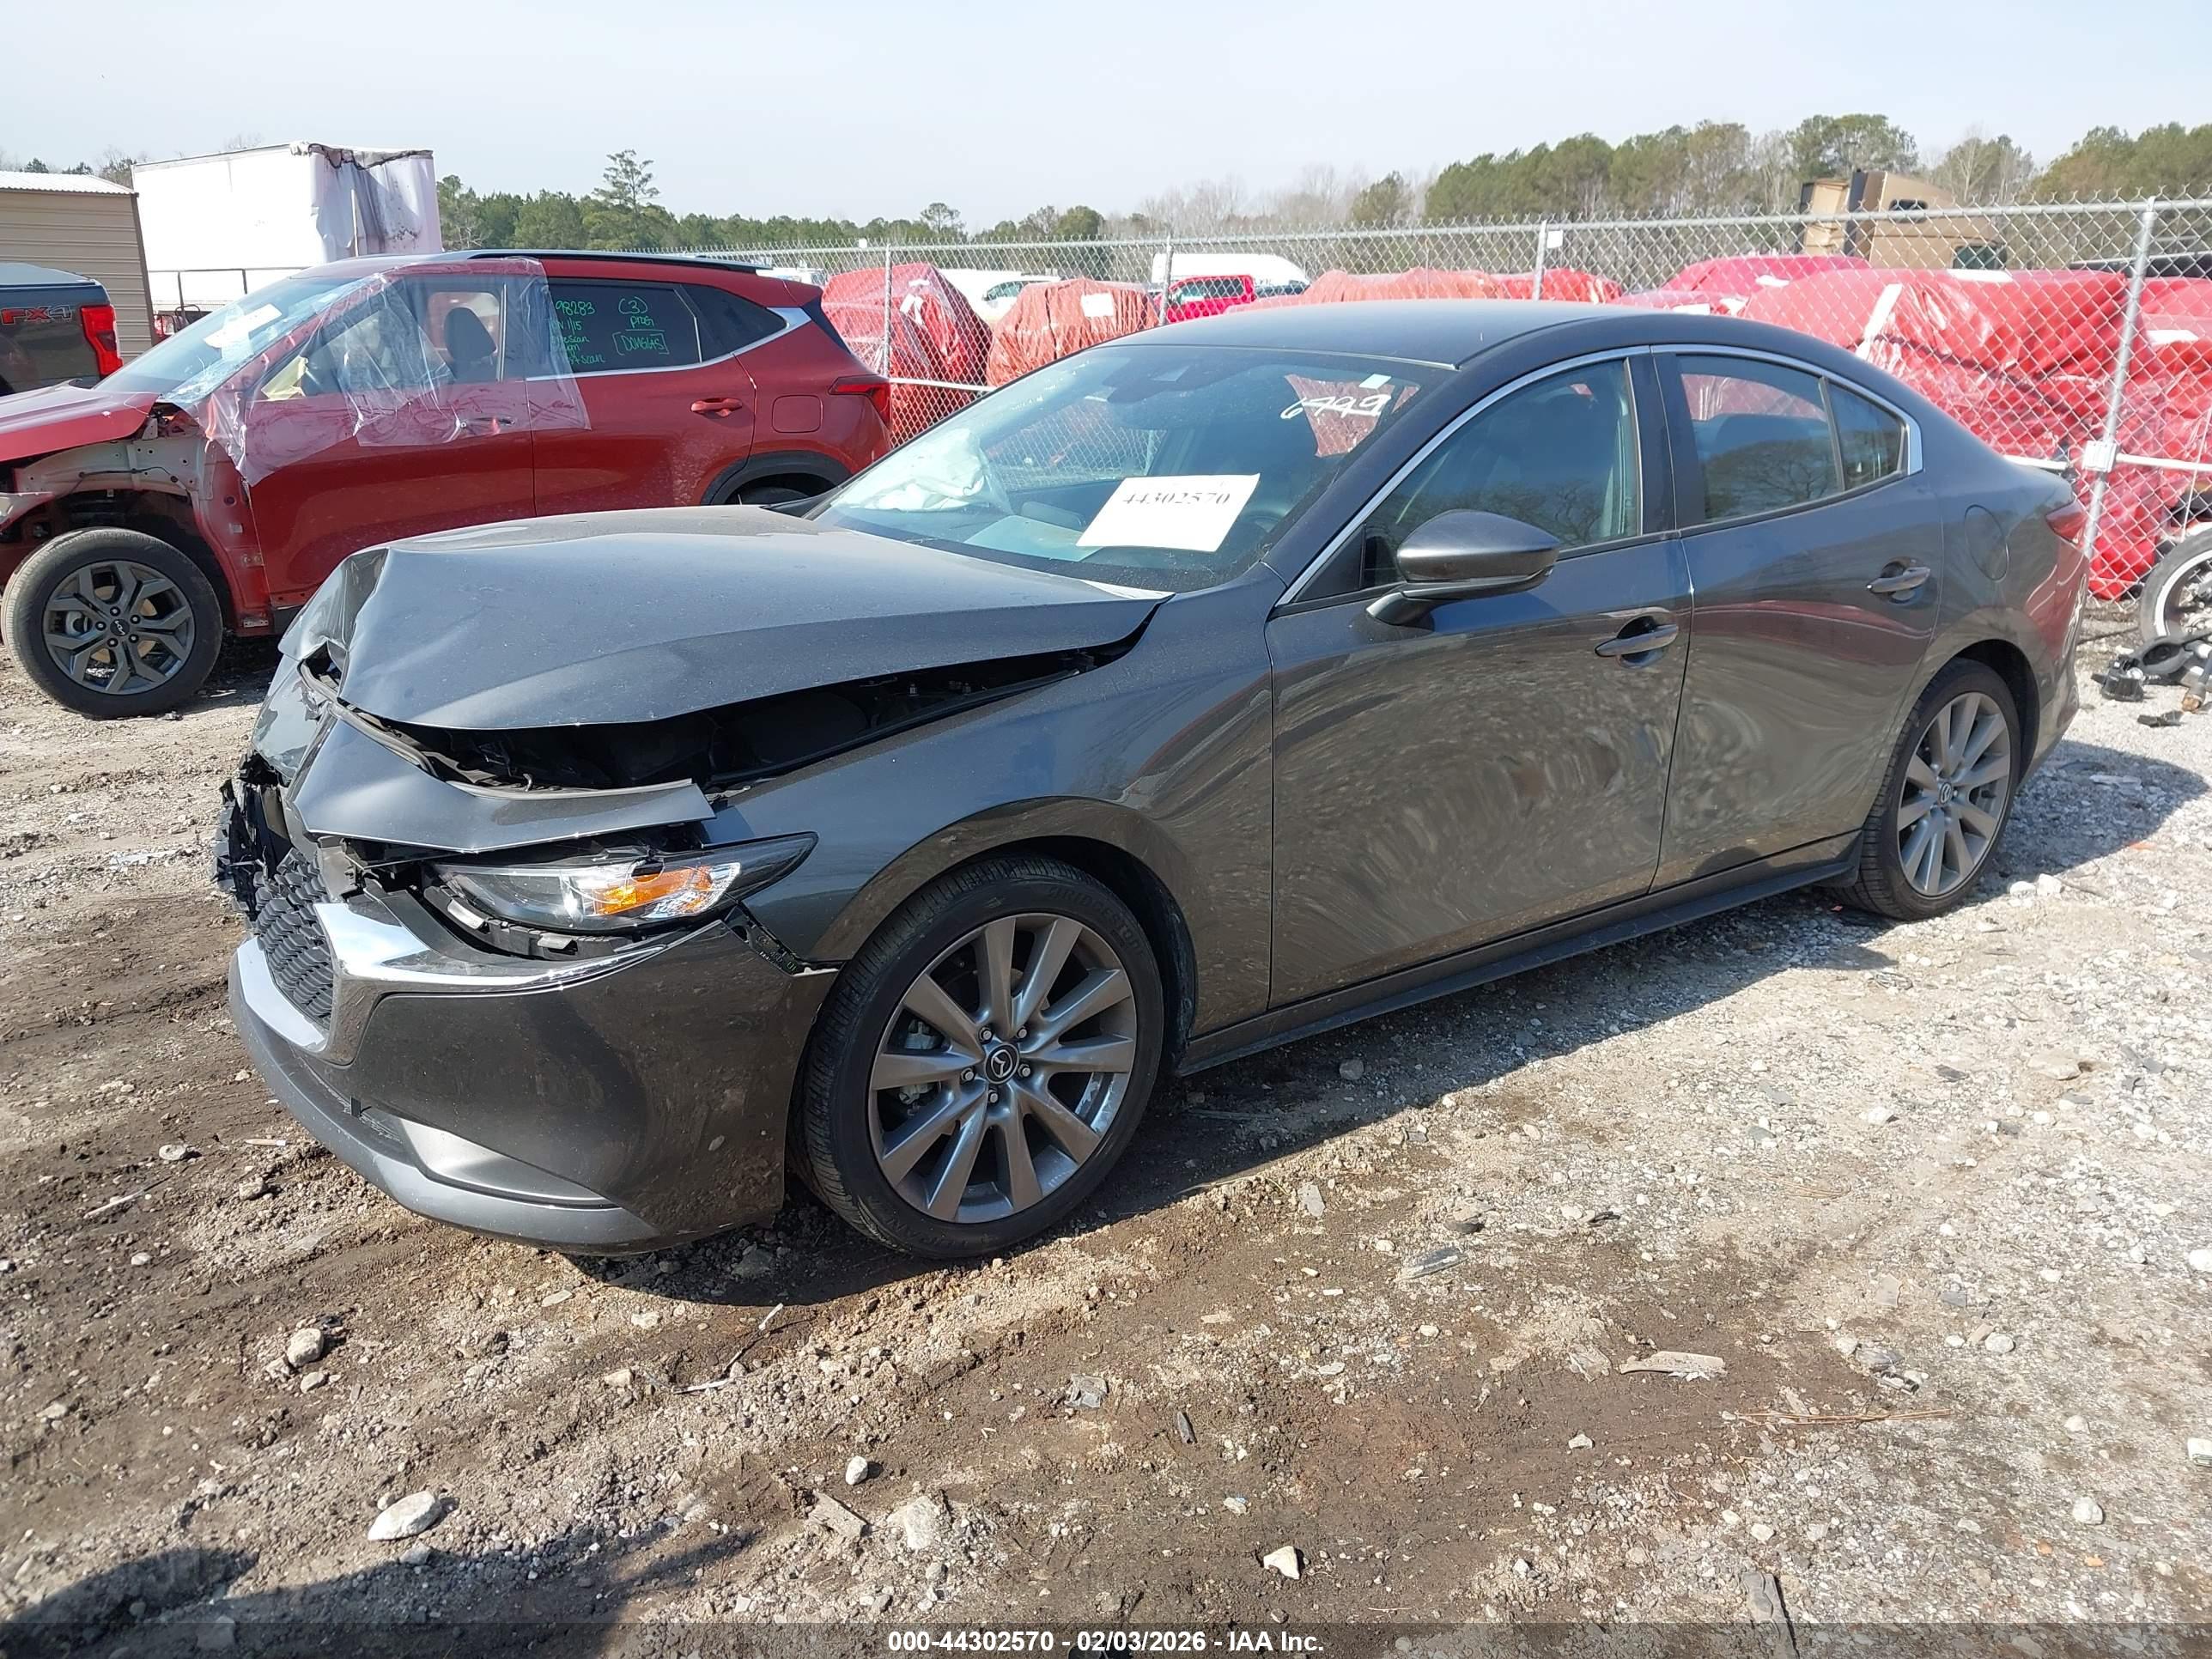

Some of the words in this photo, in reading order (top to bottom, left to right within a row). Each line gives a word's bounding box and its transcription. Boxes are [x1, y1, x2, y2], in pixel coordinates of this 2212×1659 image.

[1, 305, 72, 325] FX4
[555, 300, 596, 316] 98283
[1122, 492, 1231, 505] 44302570
